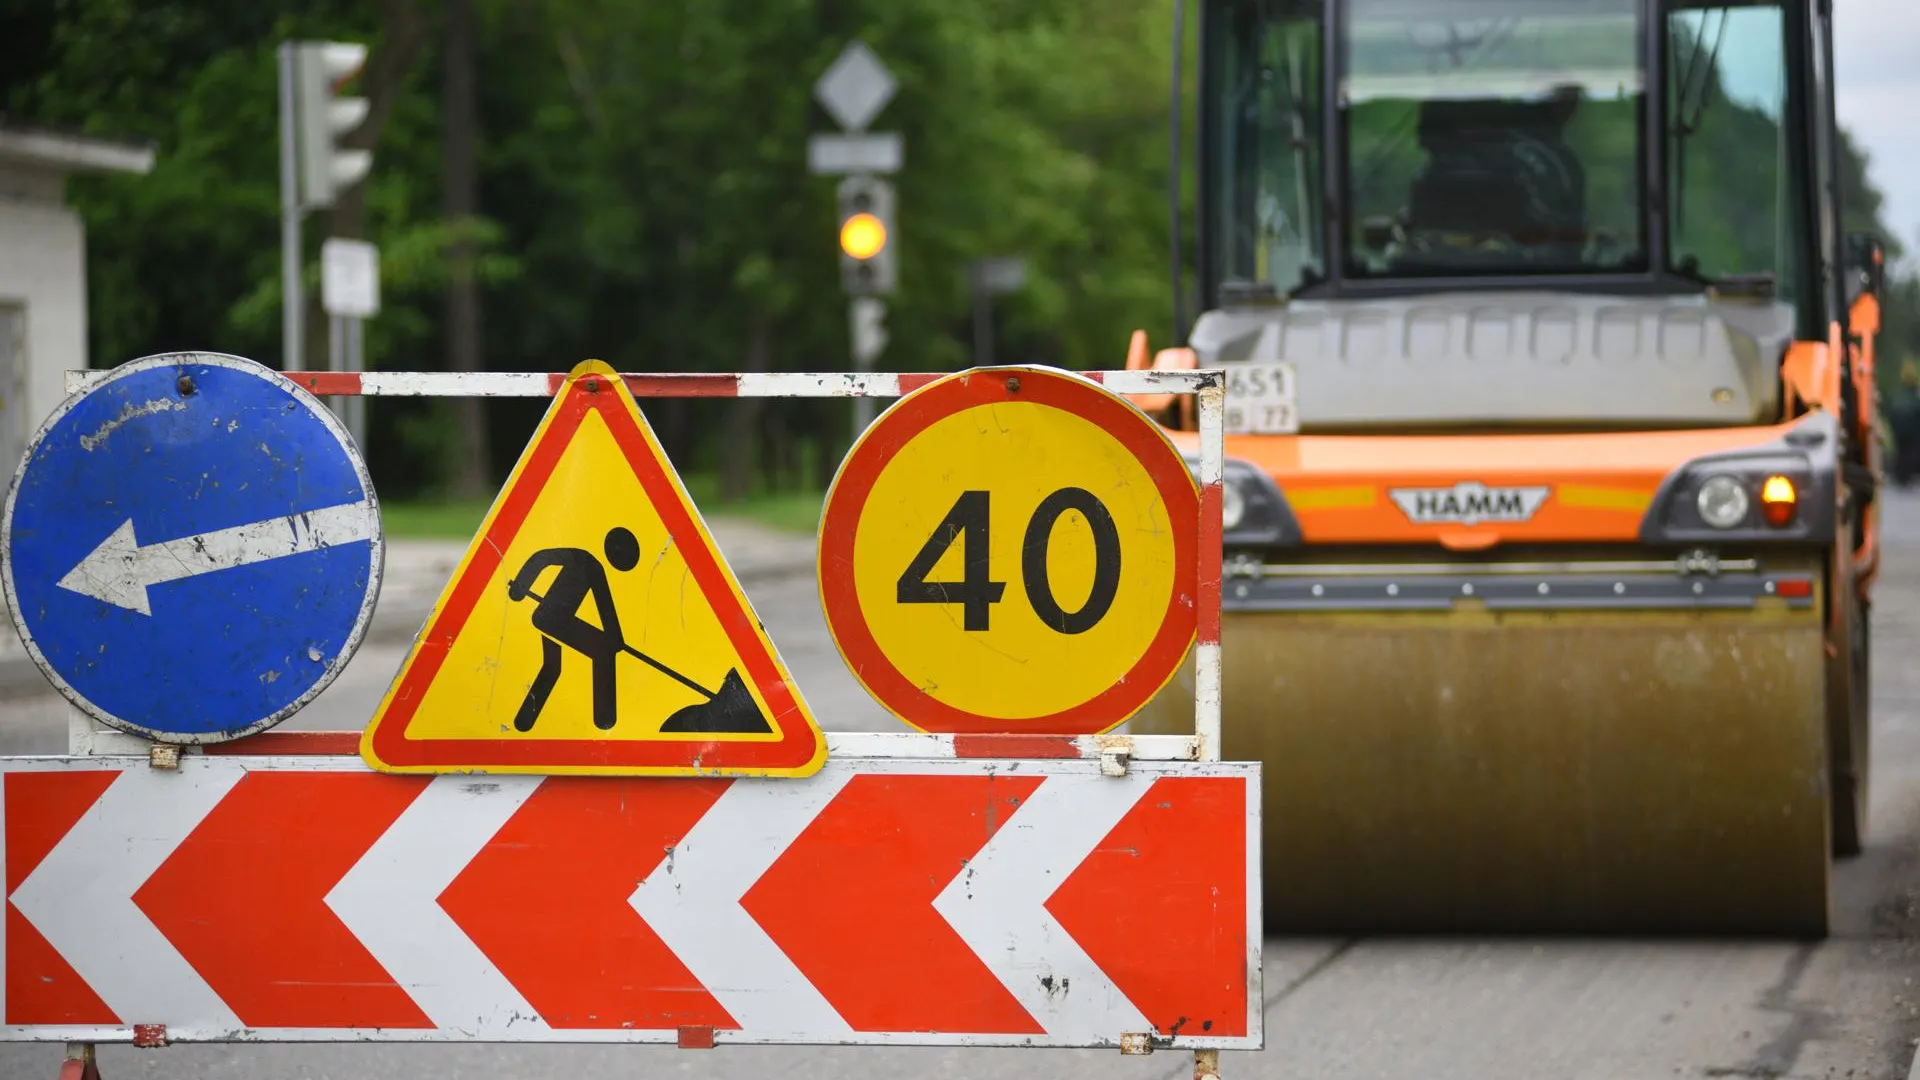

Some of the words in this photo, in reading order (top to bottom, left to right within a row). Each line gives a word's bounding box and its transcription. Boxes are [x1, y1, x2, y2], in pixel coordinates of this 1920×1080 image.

[1226, 368, 1285, 398] 651
[1264, 405, 1290, 428] 77
[1415, 491, 1523, 515] HAMM
[897, 487, 1121, 634] 40
